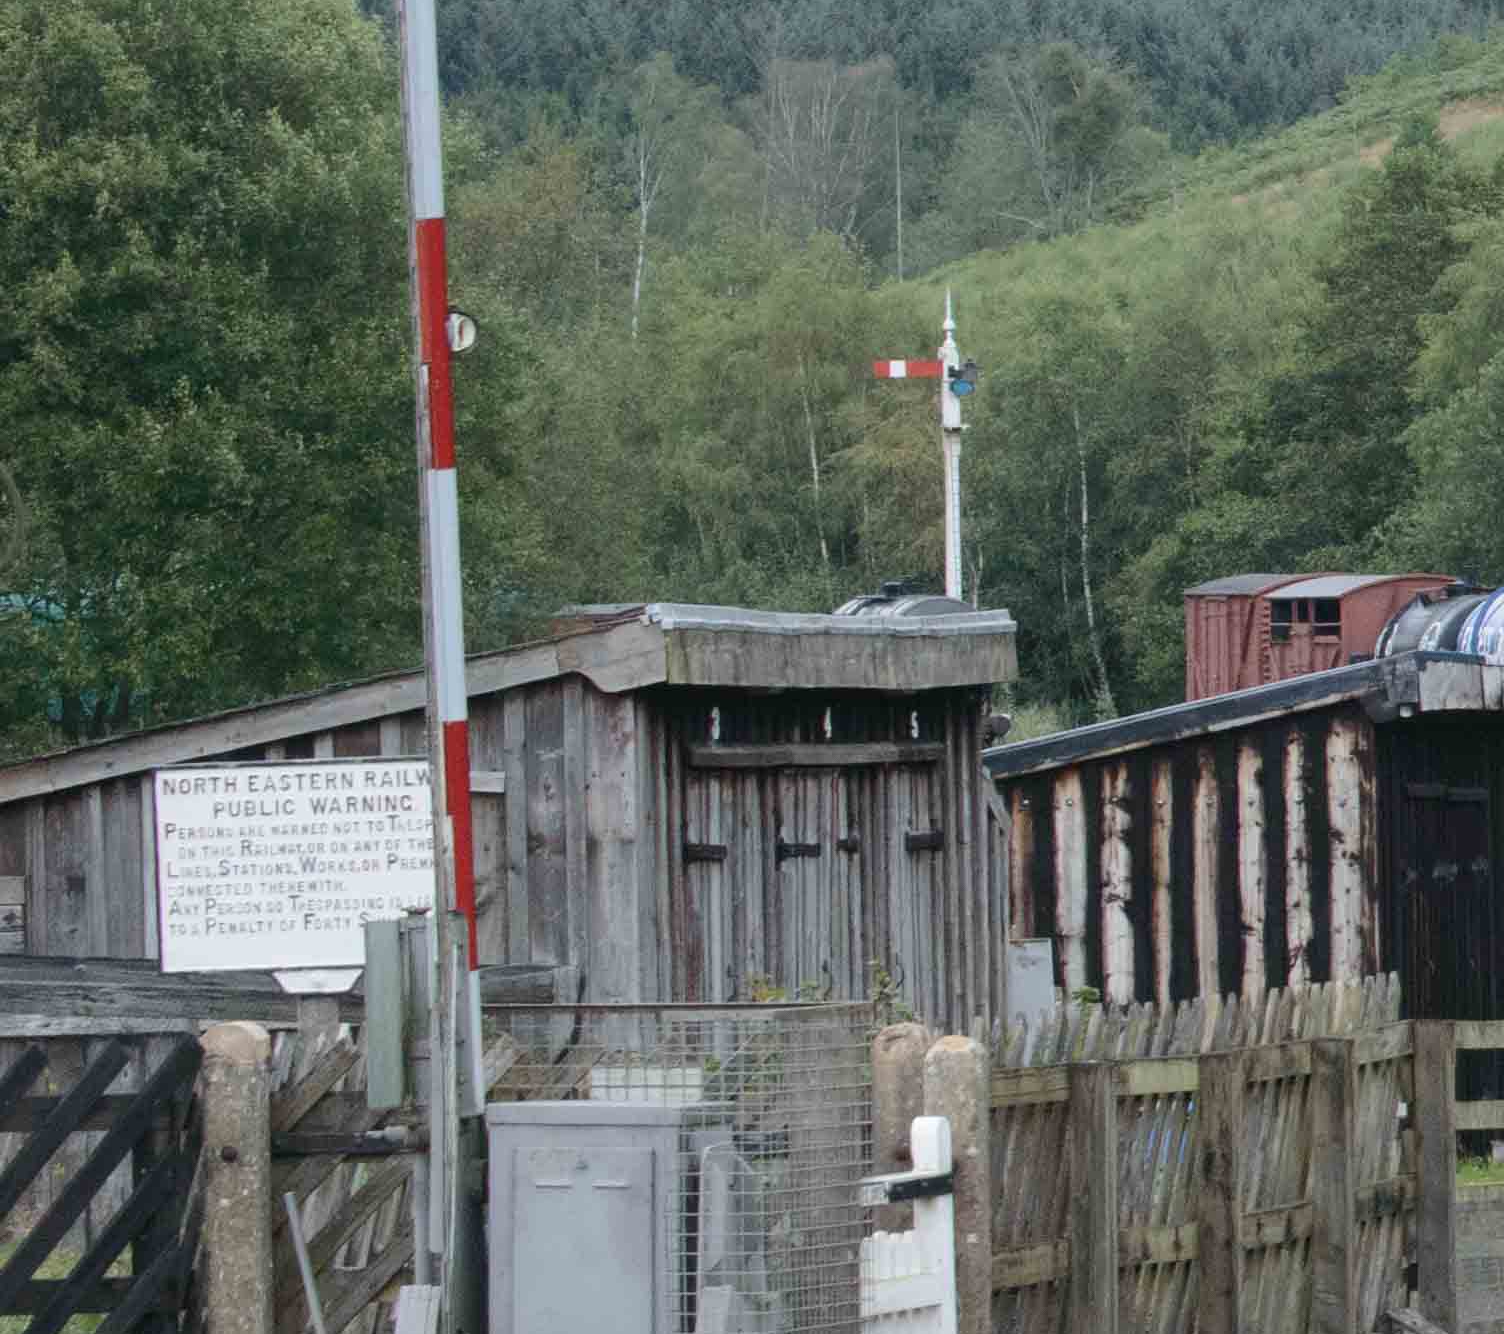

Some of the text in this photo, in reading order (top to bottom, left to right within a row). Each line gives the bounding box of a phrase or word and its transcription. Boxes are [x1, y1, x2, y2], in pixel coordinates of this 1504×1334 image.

[162, 767, 433, 796] NORTH EASTERN RAILW
[213, 798, 296, 820] PUBLIC
